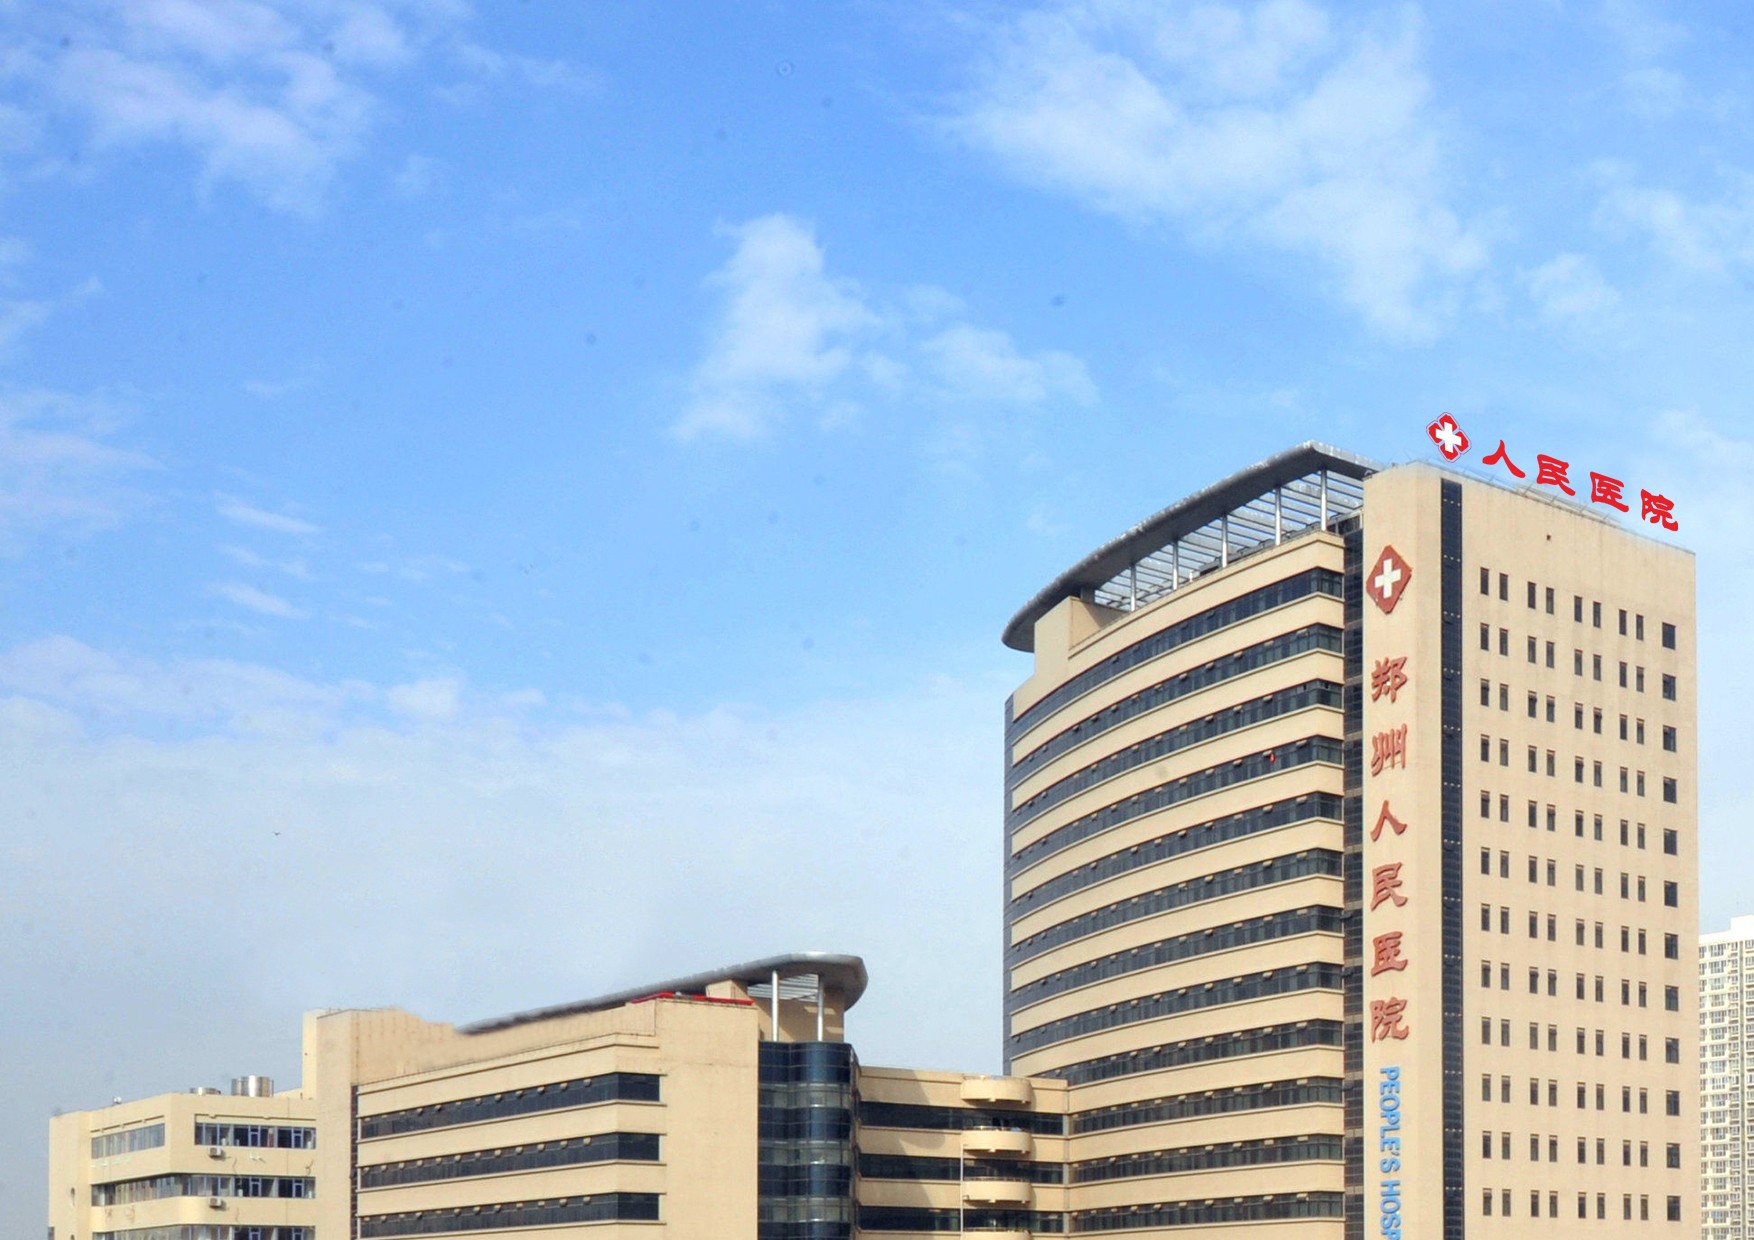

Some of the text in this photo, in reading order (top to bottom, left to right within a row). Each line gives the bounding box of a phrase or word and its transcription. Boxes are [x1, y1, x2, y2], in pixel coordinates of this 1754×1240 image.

[1481, 440, 1679, 532] 人民医院
[1370, 656, 1410, 1042] 郑州人民医院
[1380, 1066, 1401, 1173] PEOPLE'S
